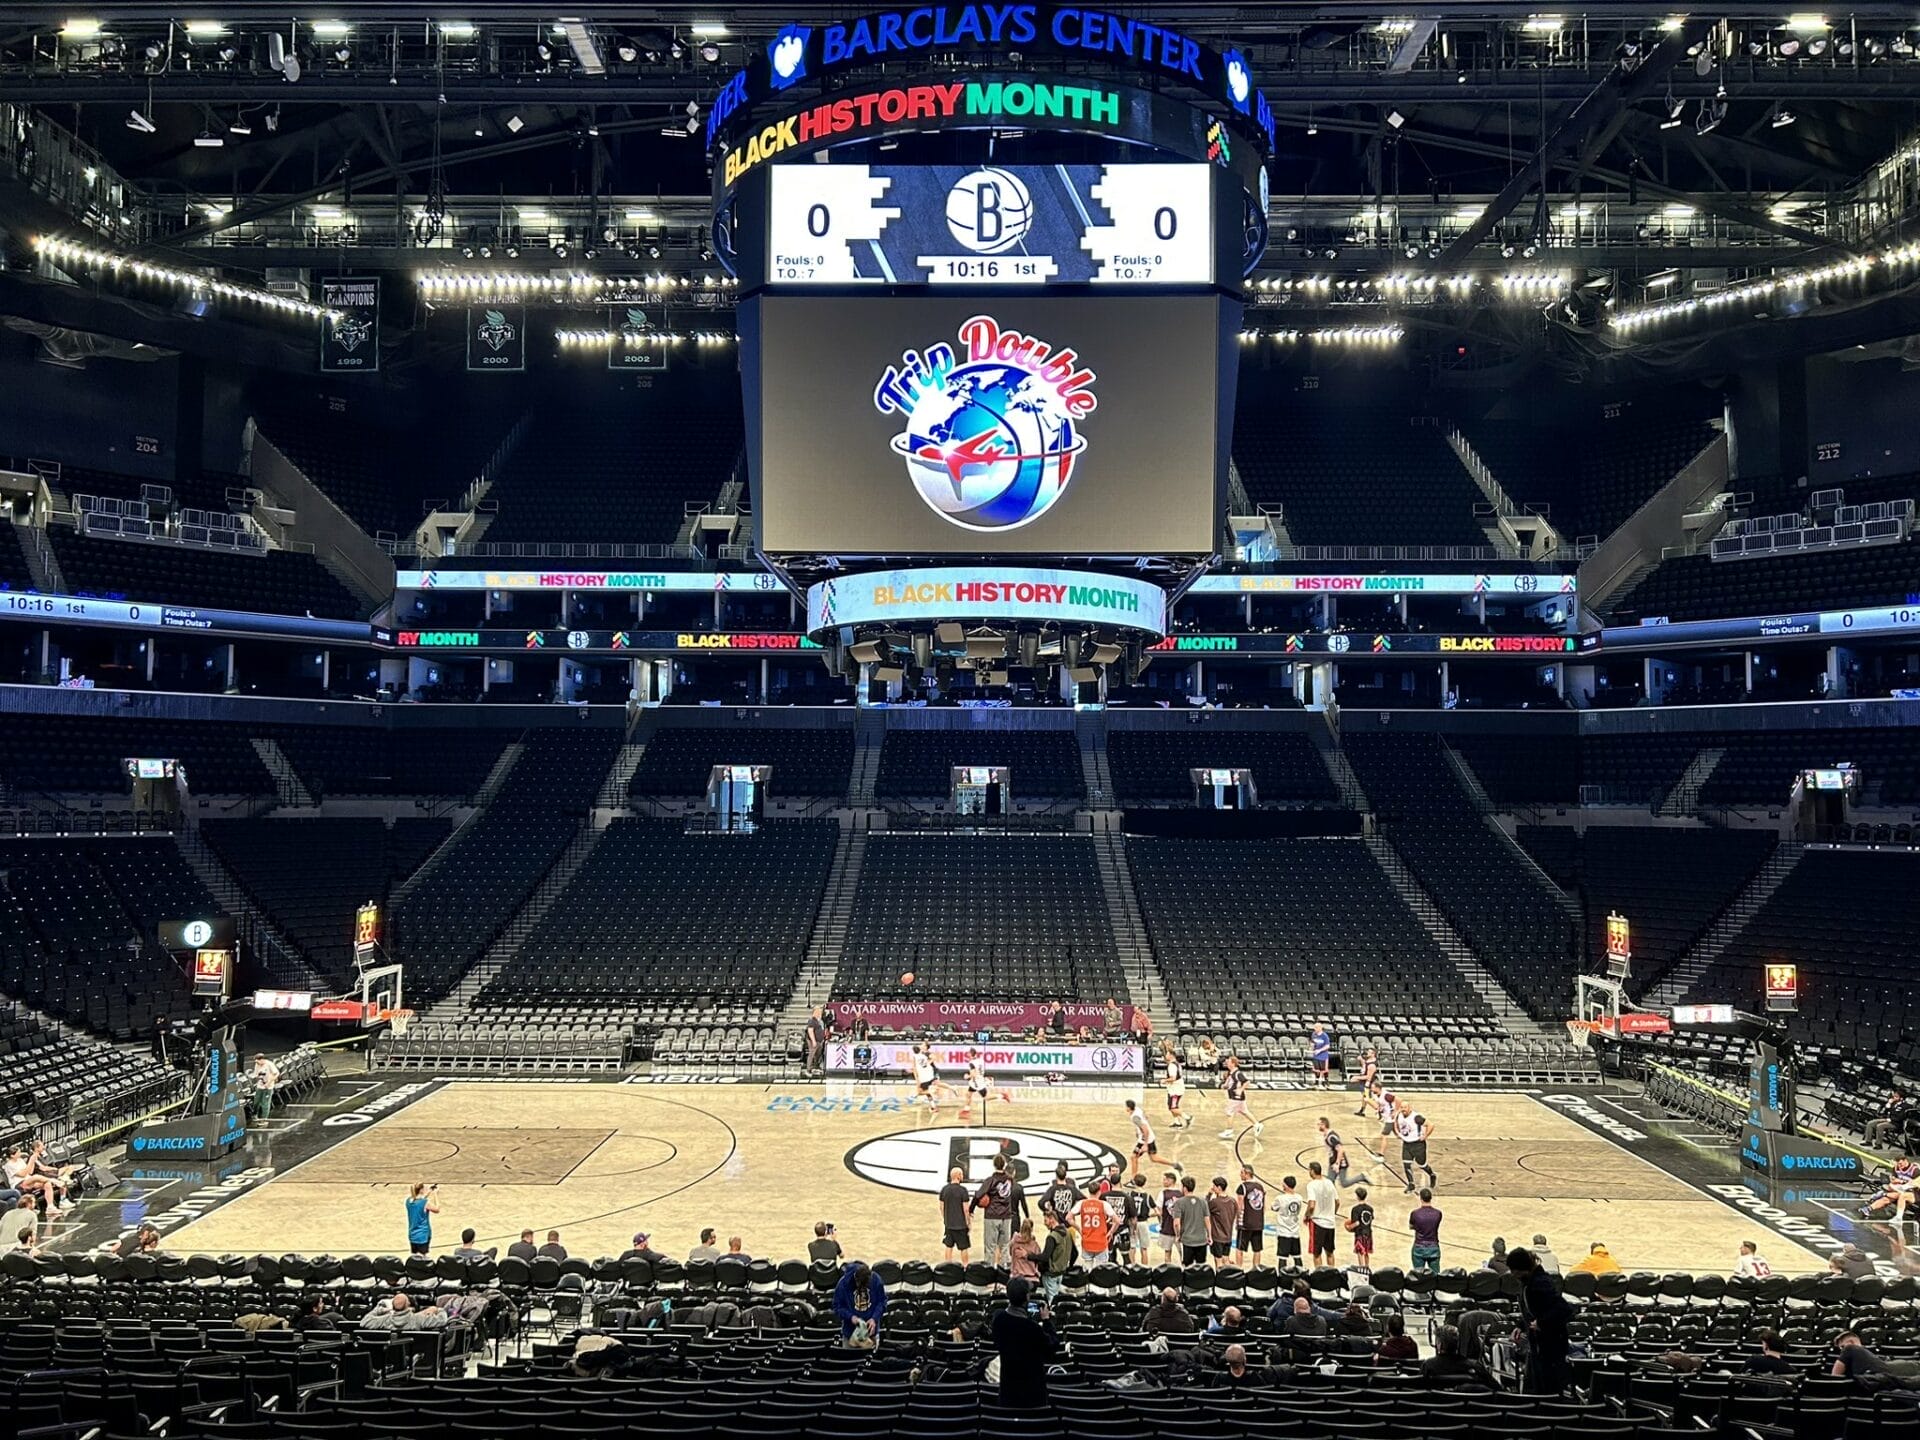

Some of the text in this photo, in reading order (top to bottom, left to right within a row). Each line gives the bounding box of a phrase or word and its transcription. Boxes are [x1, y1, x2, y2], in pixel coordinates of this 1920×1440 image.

[823, 5, 1204, 81] BARCLAYS CENTER
[725, 82, 1119, 187] BLACK HISTORY MONTH
[807, 203, 831, 237] 0
[1154, 206, 1178, 240] 0
[776, 255, 824, 265] Fouls: 0
[1113, 255, 1162, 265] Fouls: 0
[807, 268, 815, 278] 7
[947, 261, 1037, 277] 10:16 1st
[1144, 268, 1152, 278] 7
[624, 355, 650, 363] 2002
[876, 318, 1095, 417] Trip Double
[1604, 408, 1621, 418] 211
[136, 442, 157, 453] 204
[1816, 442, 1841, 450] SECTION
[1818, 449, 1840, 460] 212
[540, 574, 607, 587] HISTORY
[607, 574, 666, 587] MONTH
[1295, 576, 1364, 589] HISTORY
[1364, 576, 1424, 589] MONTH
[873, 582, 1139, 612] BLACK HISTORY MONTH
[8, 596, 140, 620] 10:16 1st 0
[165, 617, 185, 626] Time
[1842, 613, 1854, 628] 0
[1760, 627, 1780, 635] Time
[419, 632, 479, 646] MONTH
[677, 635, 732, 648] BLACK
[731, 635, 800, 648] HISTORY
[1178, 636, 1237, 650] MONTH
[1440, 638, 1495, 651] BLACK
[1495, 638, 1566, 651] HISTORY
[840, 1004, 925, 1014] QATAR AIRWAYS
[939, 1004, 1025, 1015] QATAR AIRWAYS
[1016, 1052, 1073, 1065] MONTH
[1768, 1073, 1778, 1111] BARCLAYS
[766, 1103, 904, 1112] CENTER
[147, 1137, 205, 1150] BARCLAYS
[1797, 1156, 1857, 1169] BARCLAYS
[1083, 1214, 1101, 1228] 26
[1751, 1262, 1771, 1277] 13
